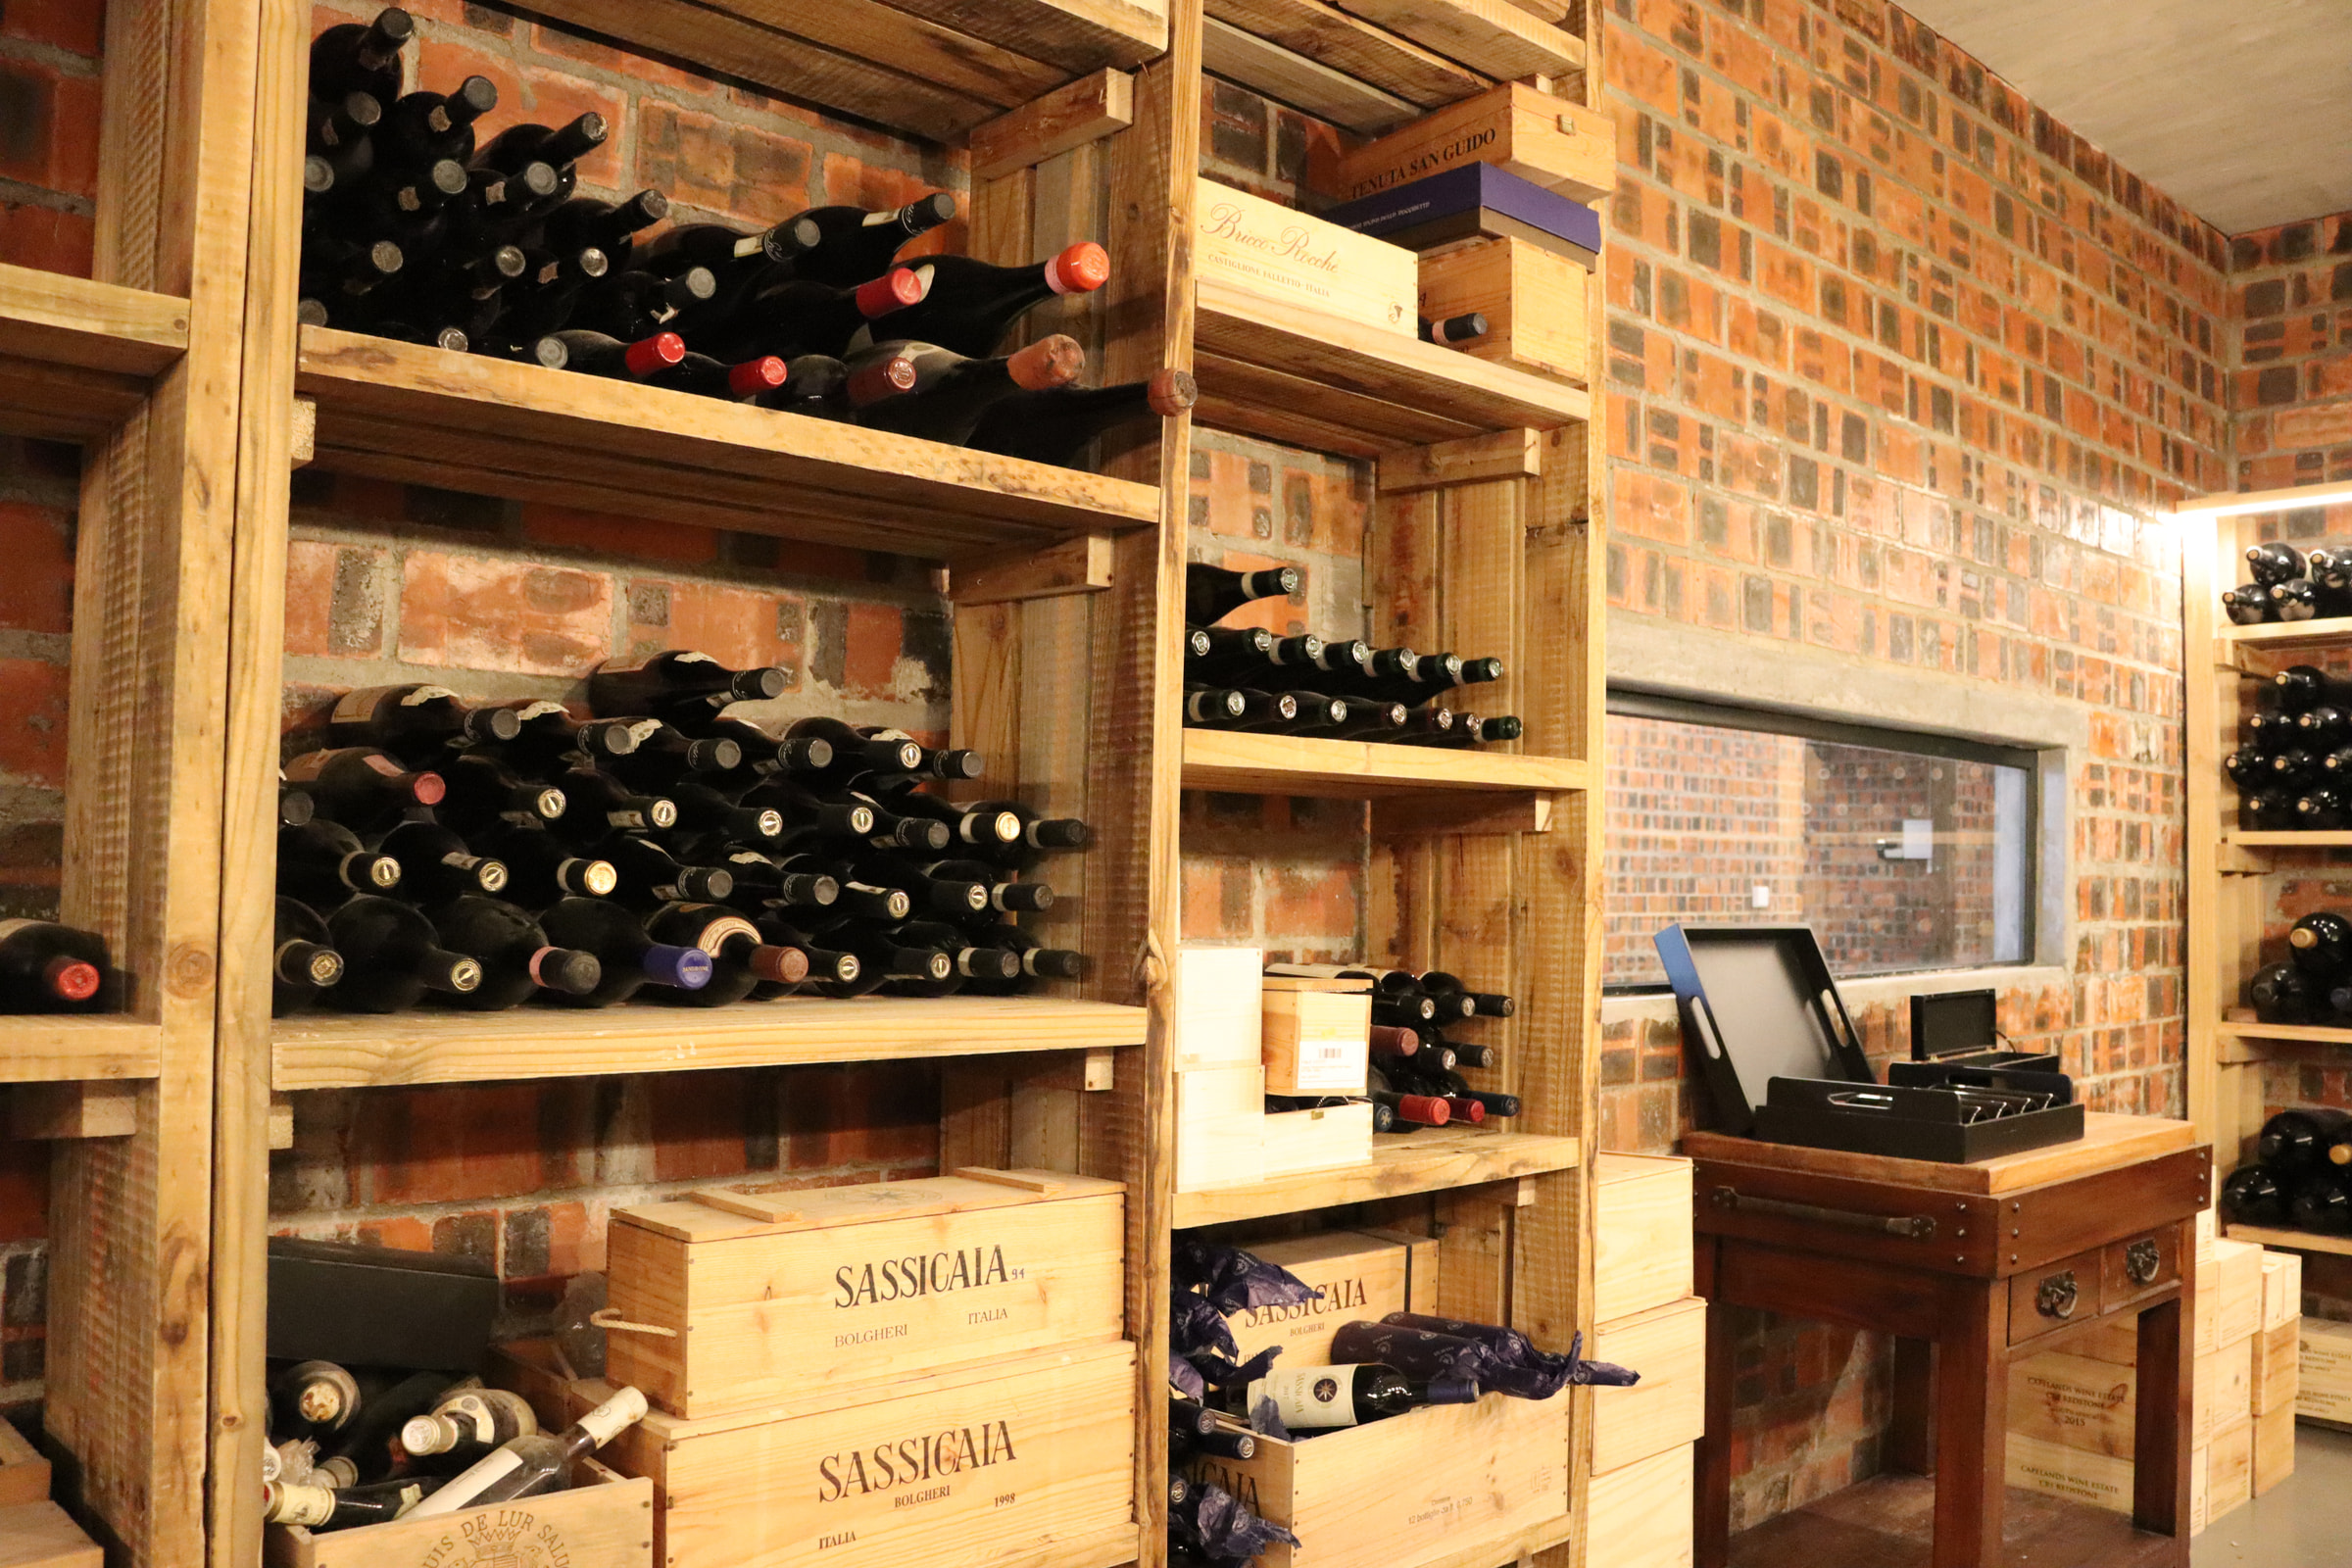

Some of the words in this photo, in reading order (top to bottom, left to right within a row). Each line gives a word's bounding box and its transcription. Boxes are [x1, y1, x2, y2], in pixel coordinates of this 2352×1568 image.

[1350, 166, 1405, 199] TENUTA
[1410, 151, 1440, 176] SAN
[1443, 127, 1495, 162] GUIDO
[1200, 202, 1269, 249] Bricco
[1207, 253, 1261, 275] CASTIGLIONE
[1305, 283, 1331, 297] ITALIA
[835, 1244, 1008, 1308] SASSICAIA
[968, 1307, 1008, 1325] ITALIA
[1290, 1322, 1325, 1338] BOLGHERI
[835, 1324, 907, 1348] BOLGHERI
[819, 1420, 1016, 1503] SASSICAIA
[895, 1485, 951, 1508] BOLGHERI
[994, 1493, 1016, 1508] 1998
[422, 1536, 454, 1568] UIS
[461, 1514, 487, 1539] DE
[498, 1510, 534, 1532] LUR
[538, 1524, 571, 1568] SALU
[818, 1531, 857, 1549] ITALIA
